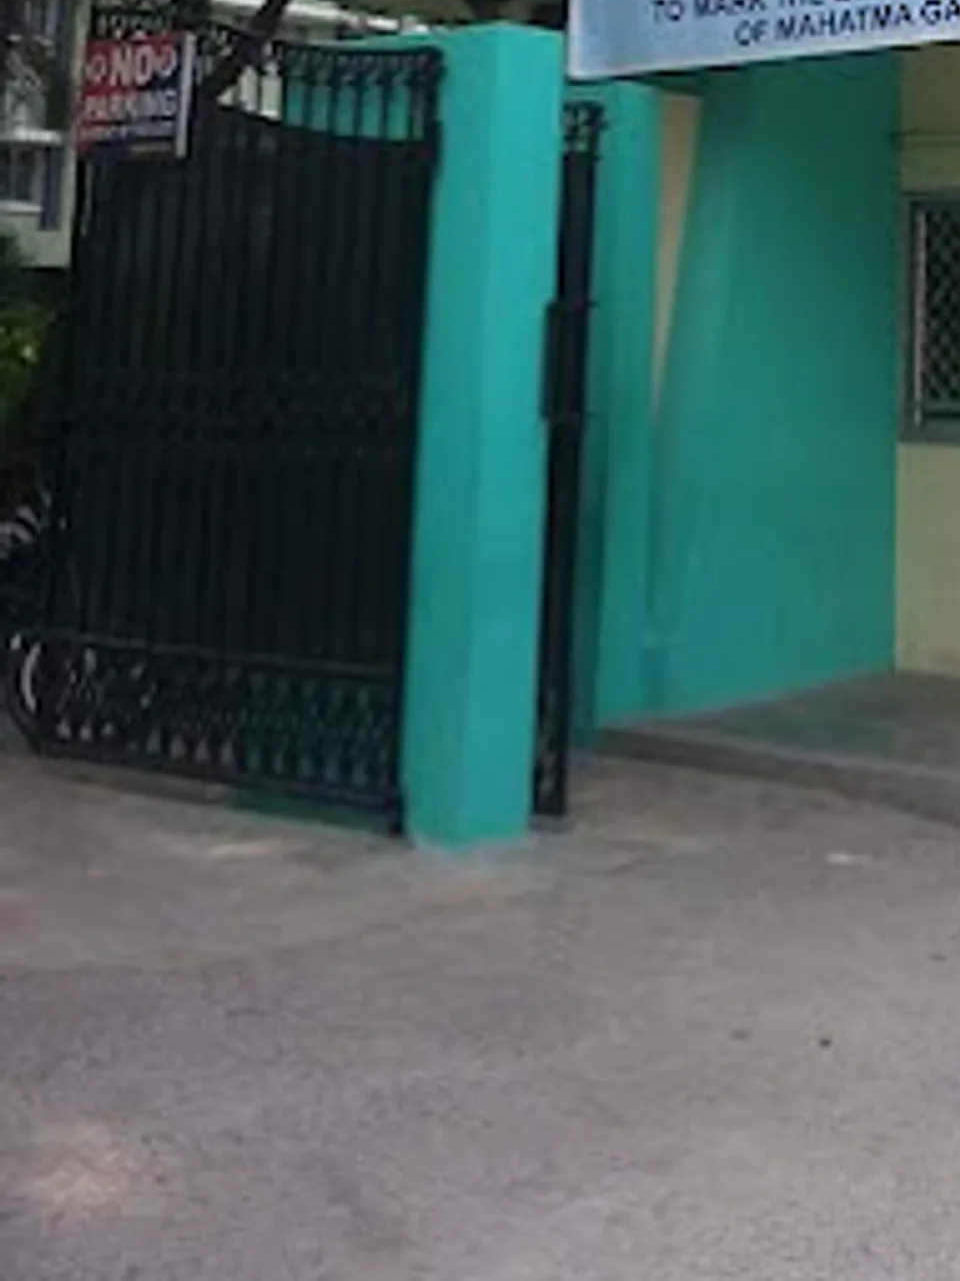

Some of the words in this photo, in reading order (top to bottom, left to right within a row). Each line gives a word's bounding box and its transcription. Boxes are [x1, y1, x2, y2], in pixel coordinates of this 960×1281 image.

[733, 19, 764, 47] OF
[773, 5, 913, 42] MAHATMA
[109, 43, 154, 86] NO
